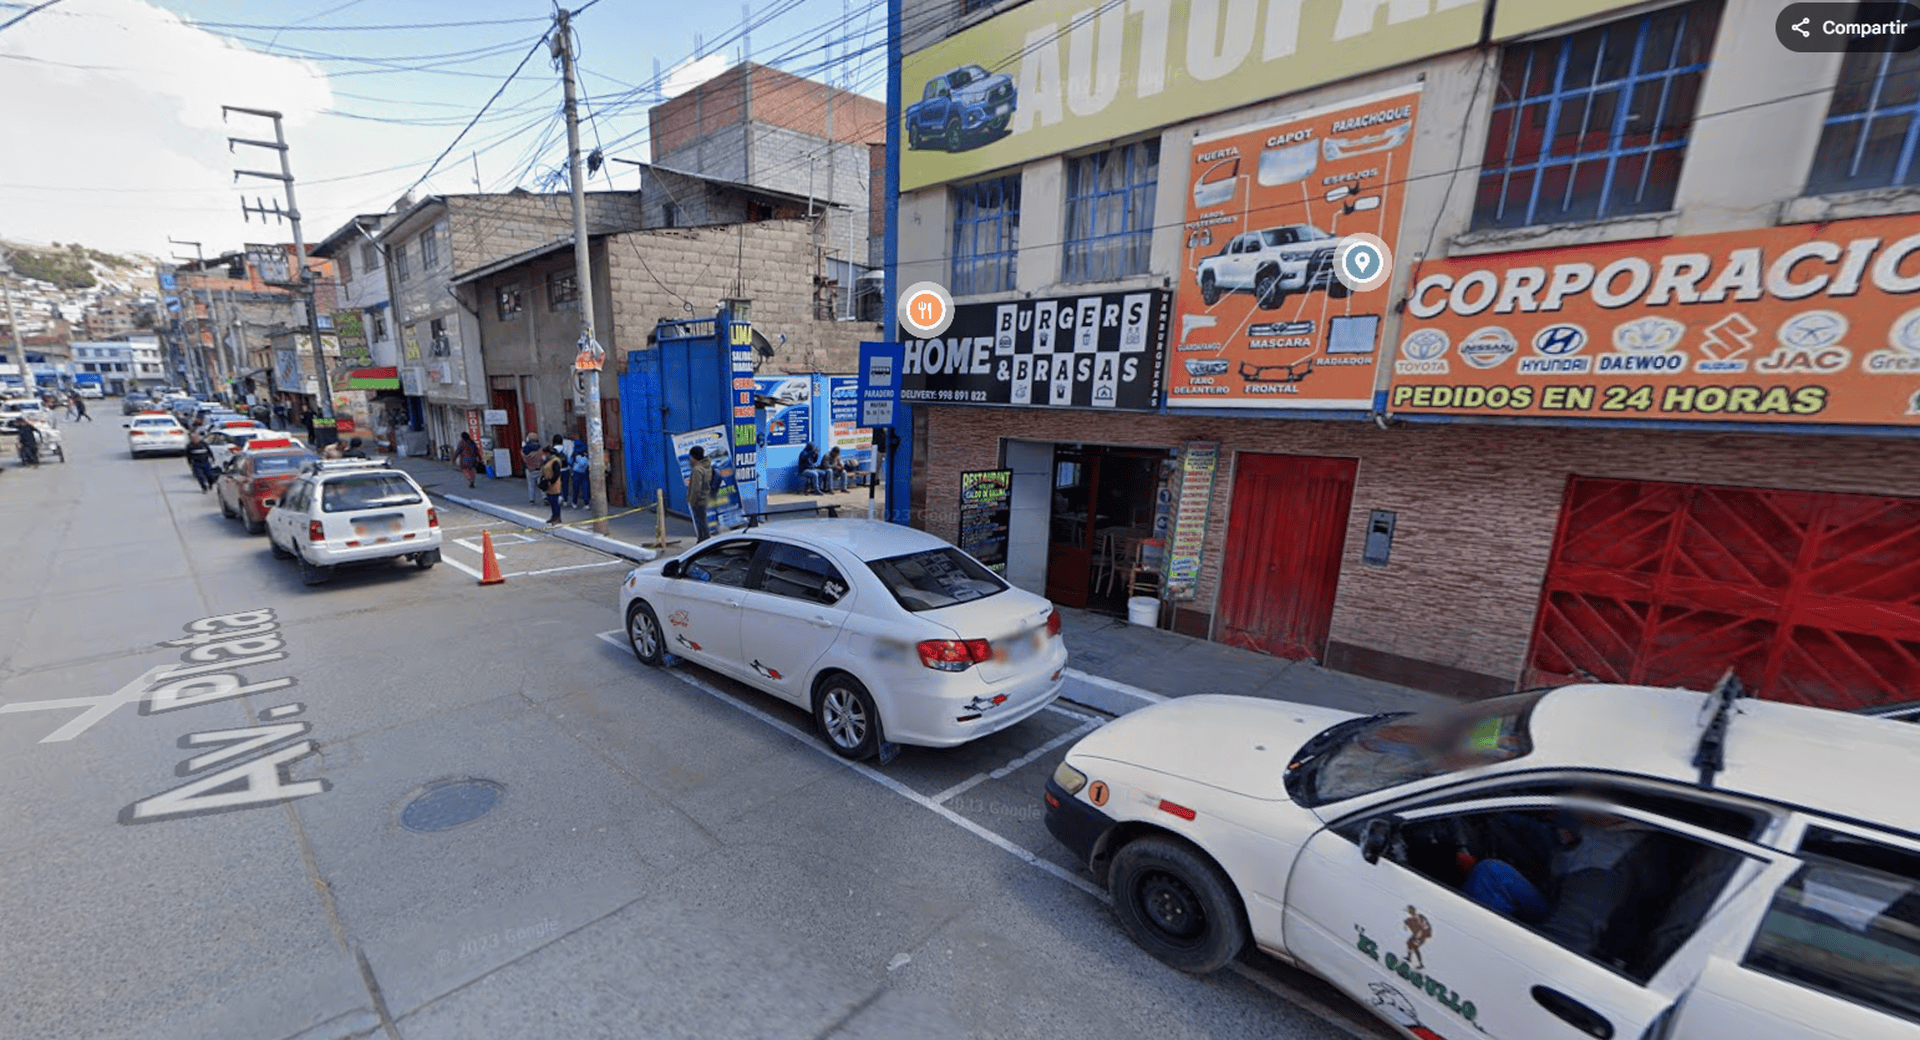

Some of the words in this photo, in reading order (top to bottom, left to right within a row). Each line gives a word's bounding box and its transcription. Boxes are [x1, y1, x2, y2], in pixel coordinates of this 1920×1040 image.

[1331, 104, 1412, 134] PARACHOQUE
[1266, 128, 1313, 148] CAPOT
[1196, 147, 1240, 163] PUERTA
[1322, 167, 1378, 186] ESPEJOS
[1199, 210, 1225, 221] FAROS
[1184, 215, 1239, 231] POSTERIORES
[1001, 302, 1143, 332] BURGERS
[1177, 343, 1222, 352] GUARDAFANGO
[1248, 337, 1312, 350] MASCARA
[1464, 343, 1513, 353] NISSAN
[902, 336, 994, 374] HOME
[1316, 356, 1373, 367] RADIADOR
[1762, 351, 1843, 369] JAC
[1016, 357, 1139, 382] BRASAS
[1397, 361, 1447, 374] TOYOTA
[1520, 359, 1588, 373] HYUNDAI
[1600, 355, 1681, 371] DAEWOO
[1699, 361, 1744, 371] SUZUKI
[1189, 377, 1215, 386] FARO
[864, 389, 894, 398] PARADERO
[900, 389, 937, 399] DELIVERY:
[938, 390, 953, 400] 998
[954, 391, 968, 400] 891
[970, 391, 987, 401] 822
[1173, 385, 1230, 396] DELANTERO
[1243, 384, 1300, 395] FRONTAL
[1393, 385, 1532, 408] PEDIDOS
[1543, 387, 1593, 410] EN
[1603, 386, 1651, 411] 24
[1663, 386, 1827, 413] HORAS
[1094, 785, 1104, 803] 1
